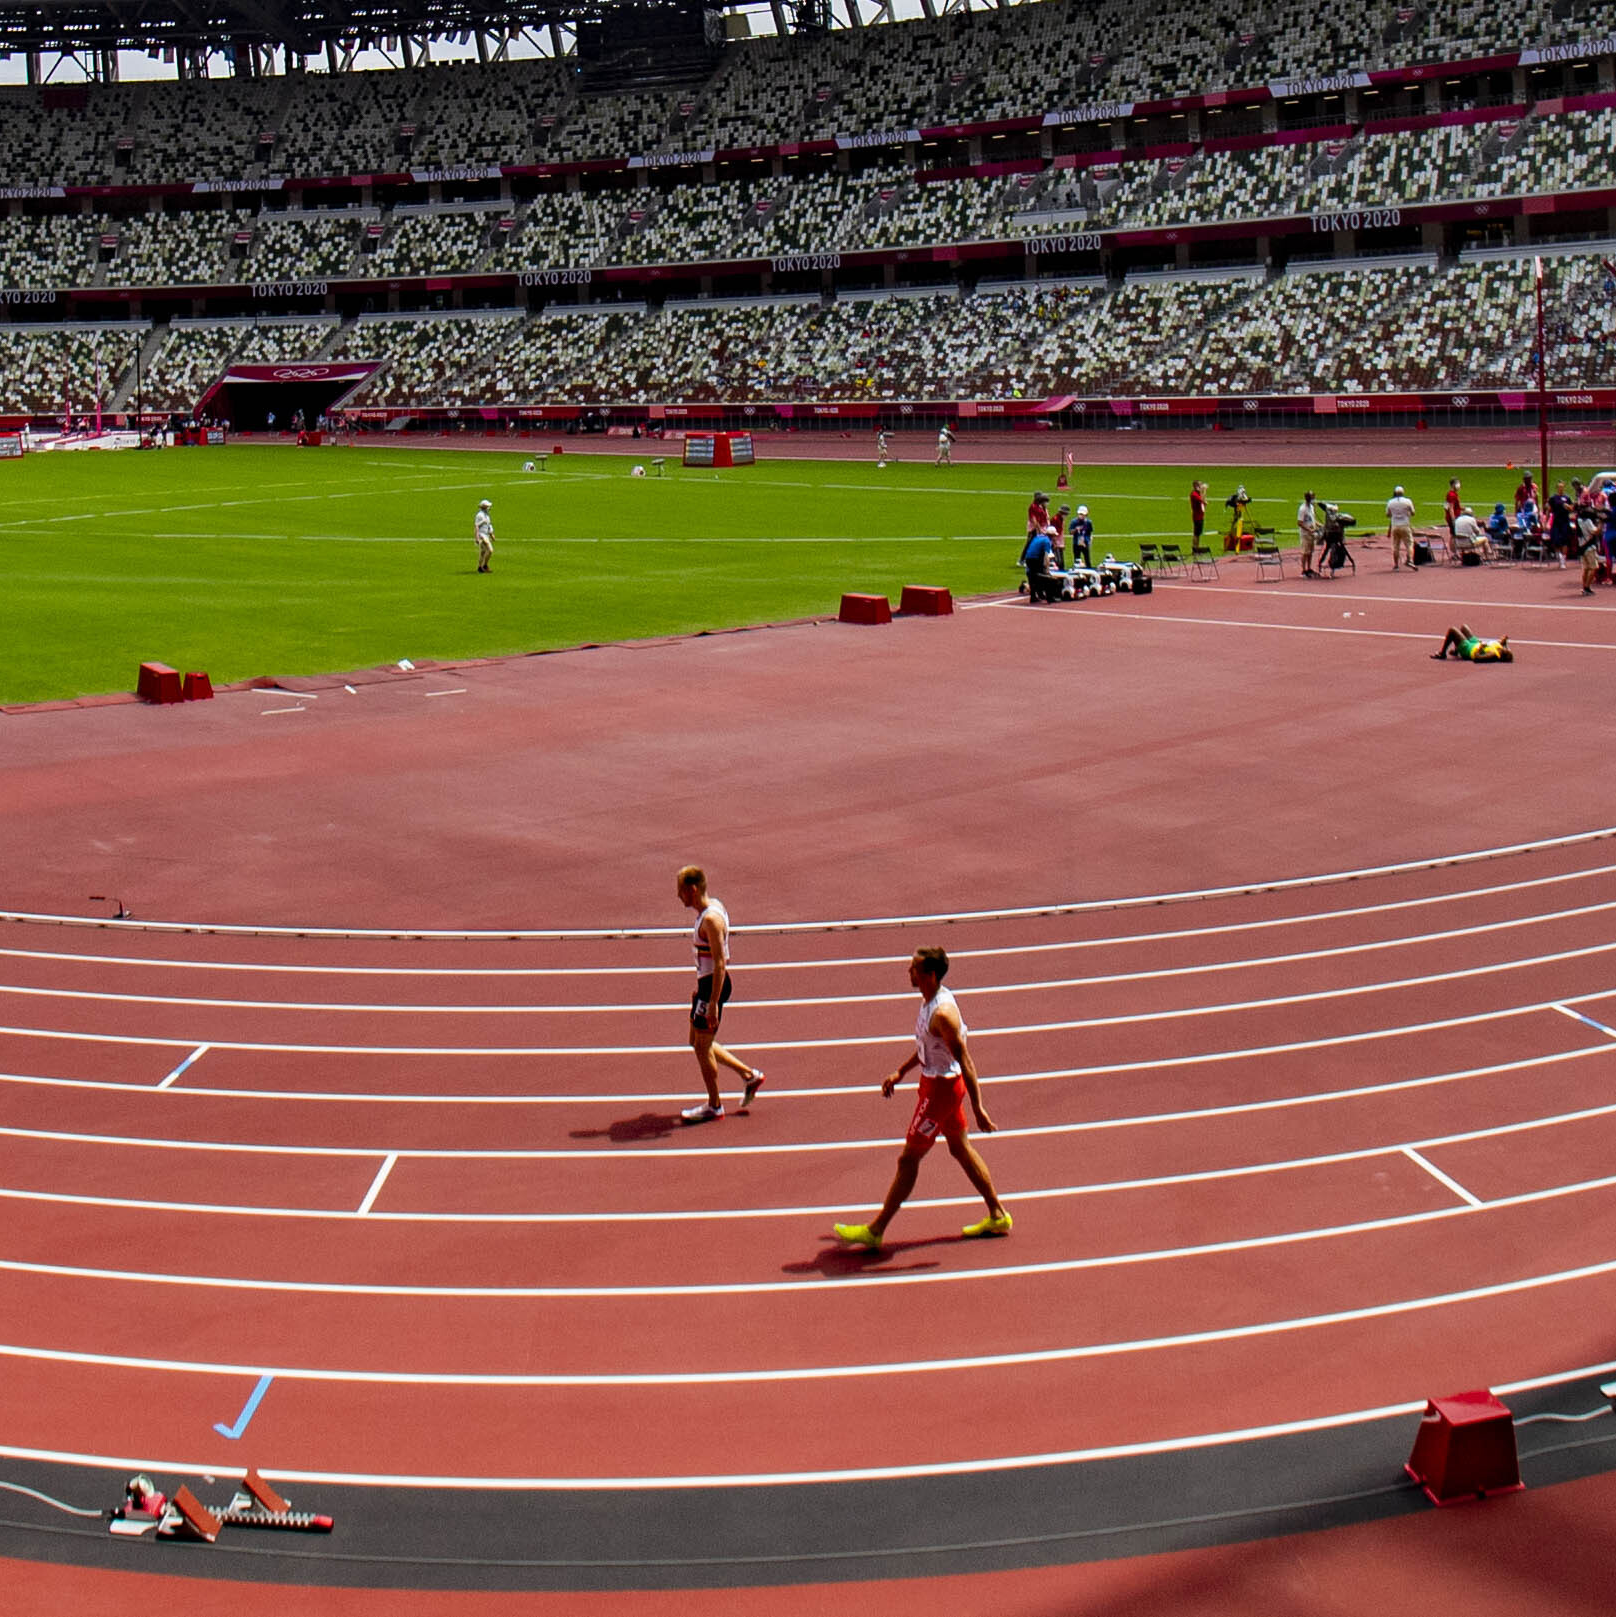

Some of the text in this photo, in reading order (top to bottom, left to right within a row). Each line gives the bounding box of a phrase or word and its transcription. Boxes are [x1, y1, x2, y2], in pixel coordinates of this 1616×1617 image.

[1538, 40, 1614, 62] TOKYO 2020
[1285, 76, 1354, 97] TOKYO 2020
[1057, 106, 1119, 123] TOKYO 2020
[850, 132, 908, 148] TOKYO 2020
[642, 152, 702, 166] TOKYO 2020
[427, 169, 489, 181] TOKYO 2020
[207, 180, 270, 191] TOKYO 2020
[24, 189, 51, 198] 2020
[1311, 210, 1400, 232] TOKYO 2020
[1023, 235, 1101, 255] TOKYO 2020
[771, 255, 840, 272] TOKYO 2020
[517, 270, 591, 286] TOKYO 2020
[24, 291, 55, 304] 2020
[251, 283, 327, 297] TOKYO 2020
[1337, 400, 1355, 408] TOKYO
[1557, 395, 1593, 404] TOKYO 2020
